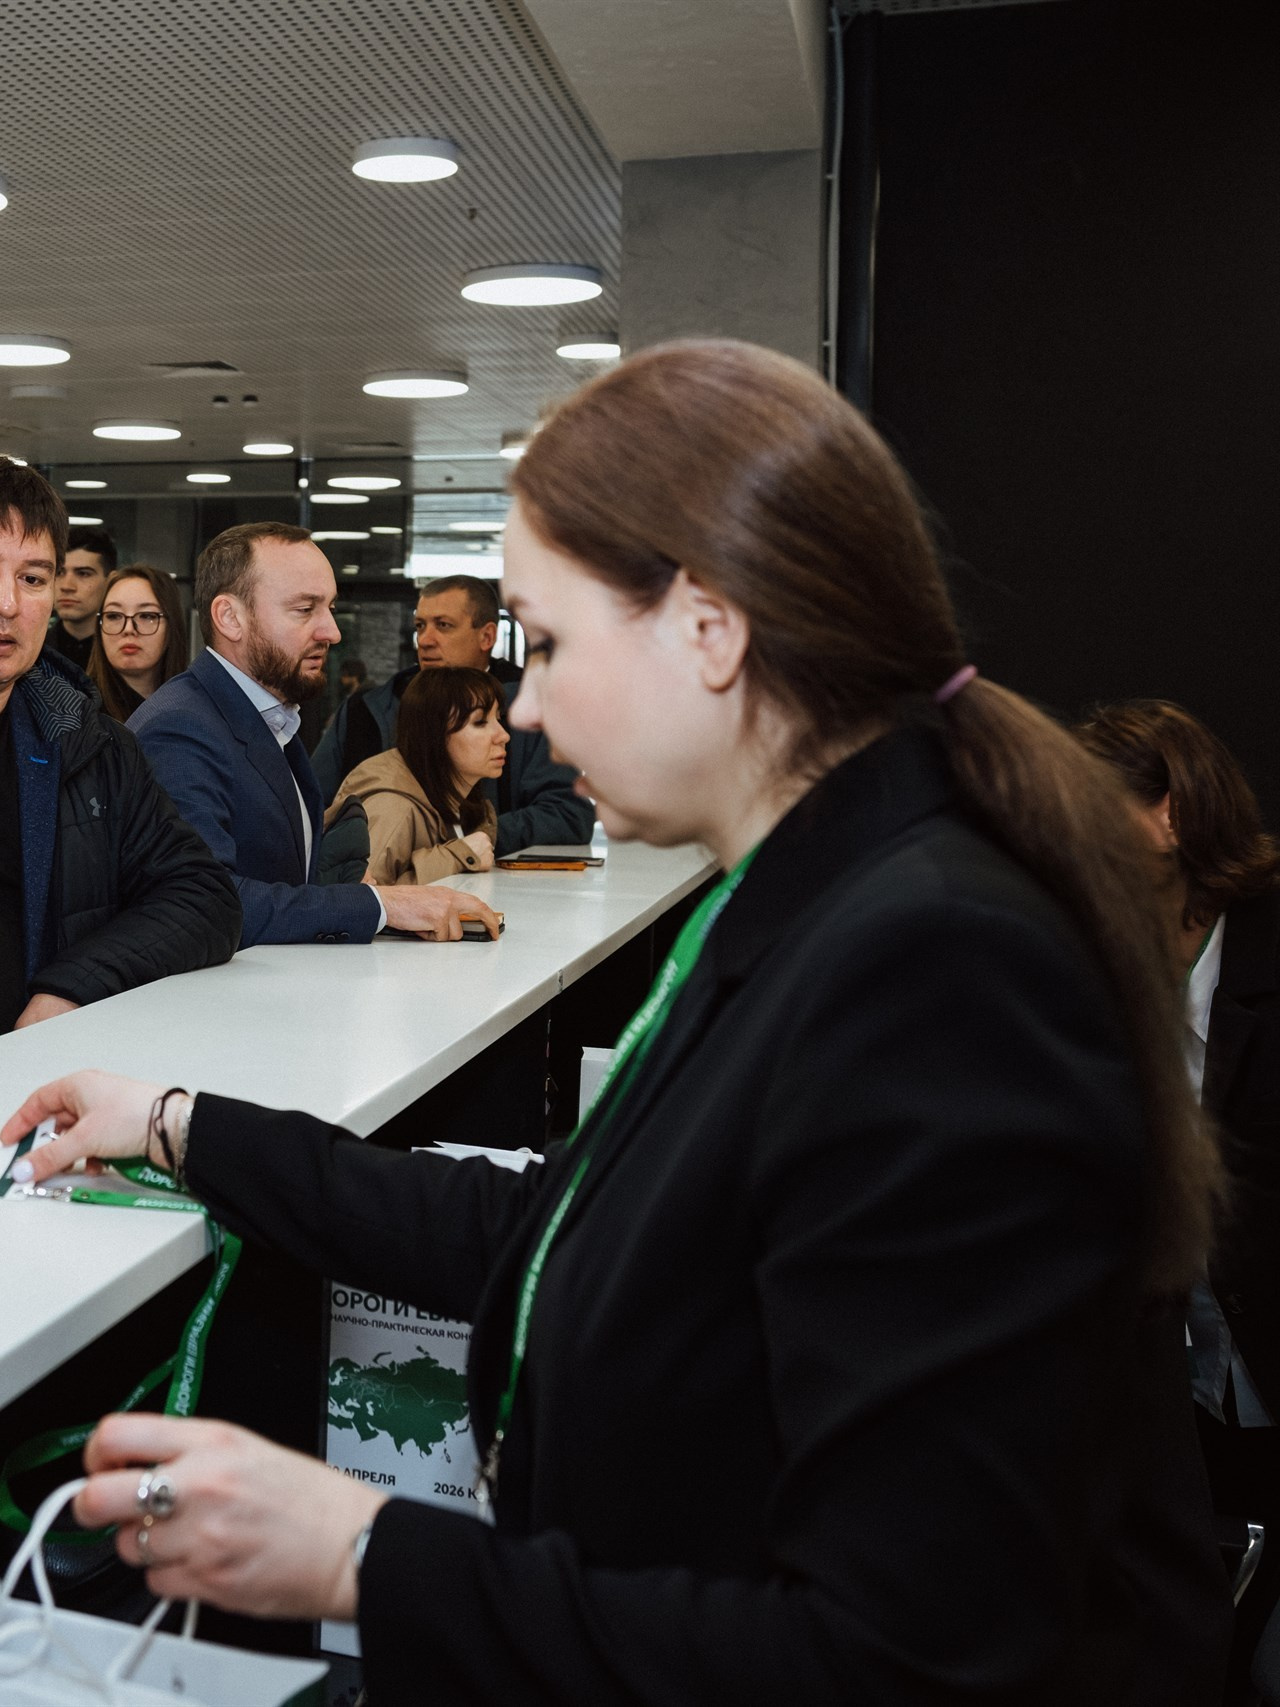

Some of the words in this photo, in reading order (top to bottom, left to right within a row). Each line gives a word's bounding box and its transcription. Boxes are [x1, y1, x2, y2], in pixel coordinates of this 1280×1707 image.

[446, 1329, 472, 1342] КОН
[174, 1356, 198, 1417] ДОРОГИ
[433, 1481, 465, 1499] 2026
